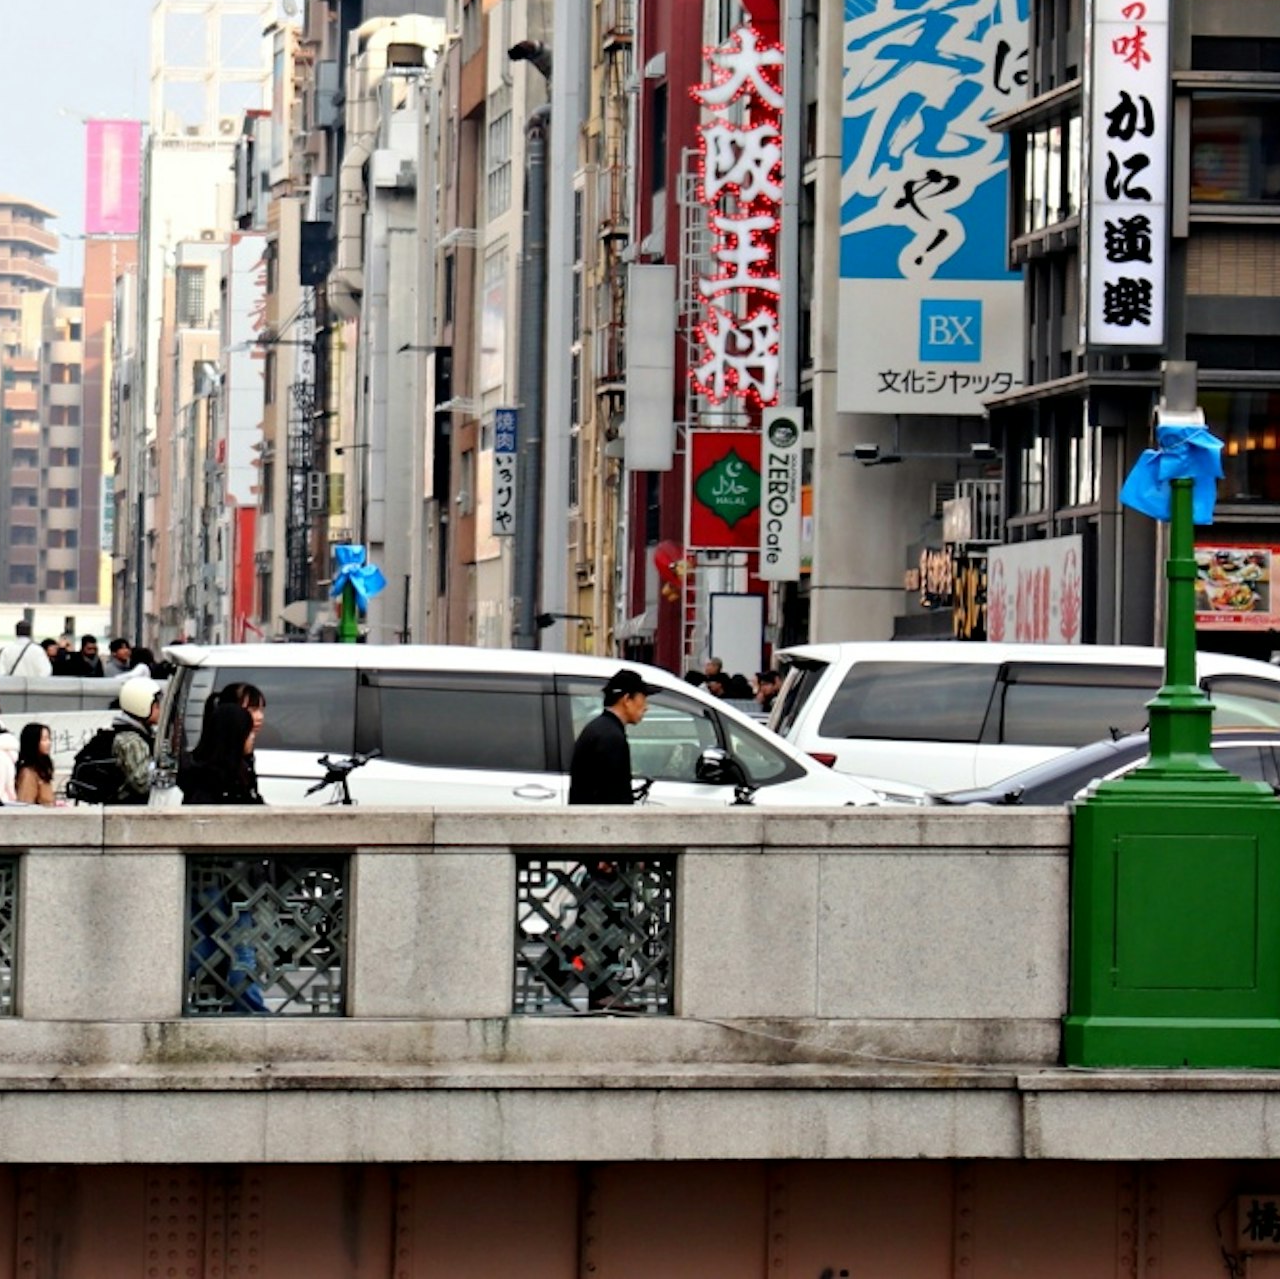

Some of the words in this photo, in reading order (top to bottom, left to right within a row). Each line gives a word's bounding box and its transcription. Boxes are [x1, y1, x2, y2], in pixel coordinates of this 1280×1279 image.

[688, 25, 785, 410] 大阪王将
[928, 315, 975, 347] BX
[495, 411, 517, 452] 焼肉
[495, 454, 514, 532] いろりや
[715, 496, 746, 505] HALAL
[767, 453, 790, 517] ZERO
[766, 518, 783, 564] Cafe
